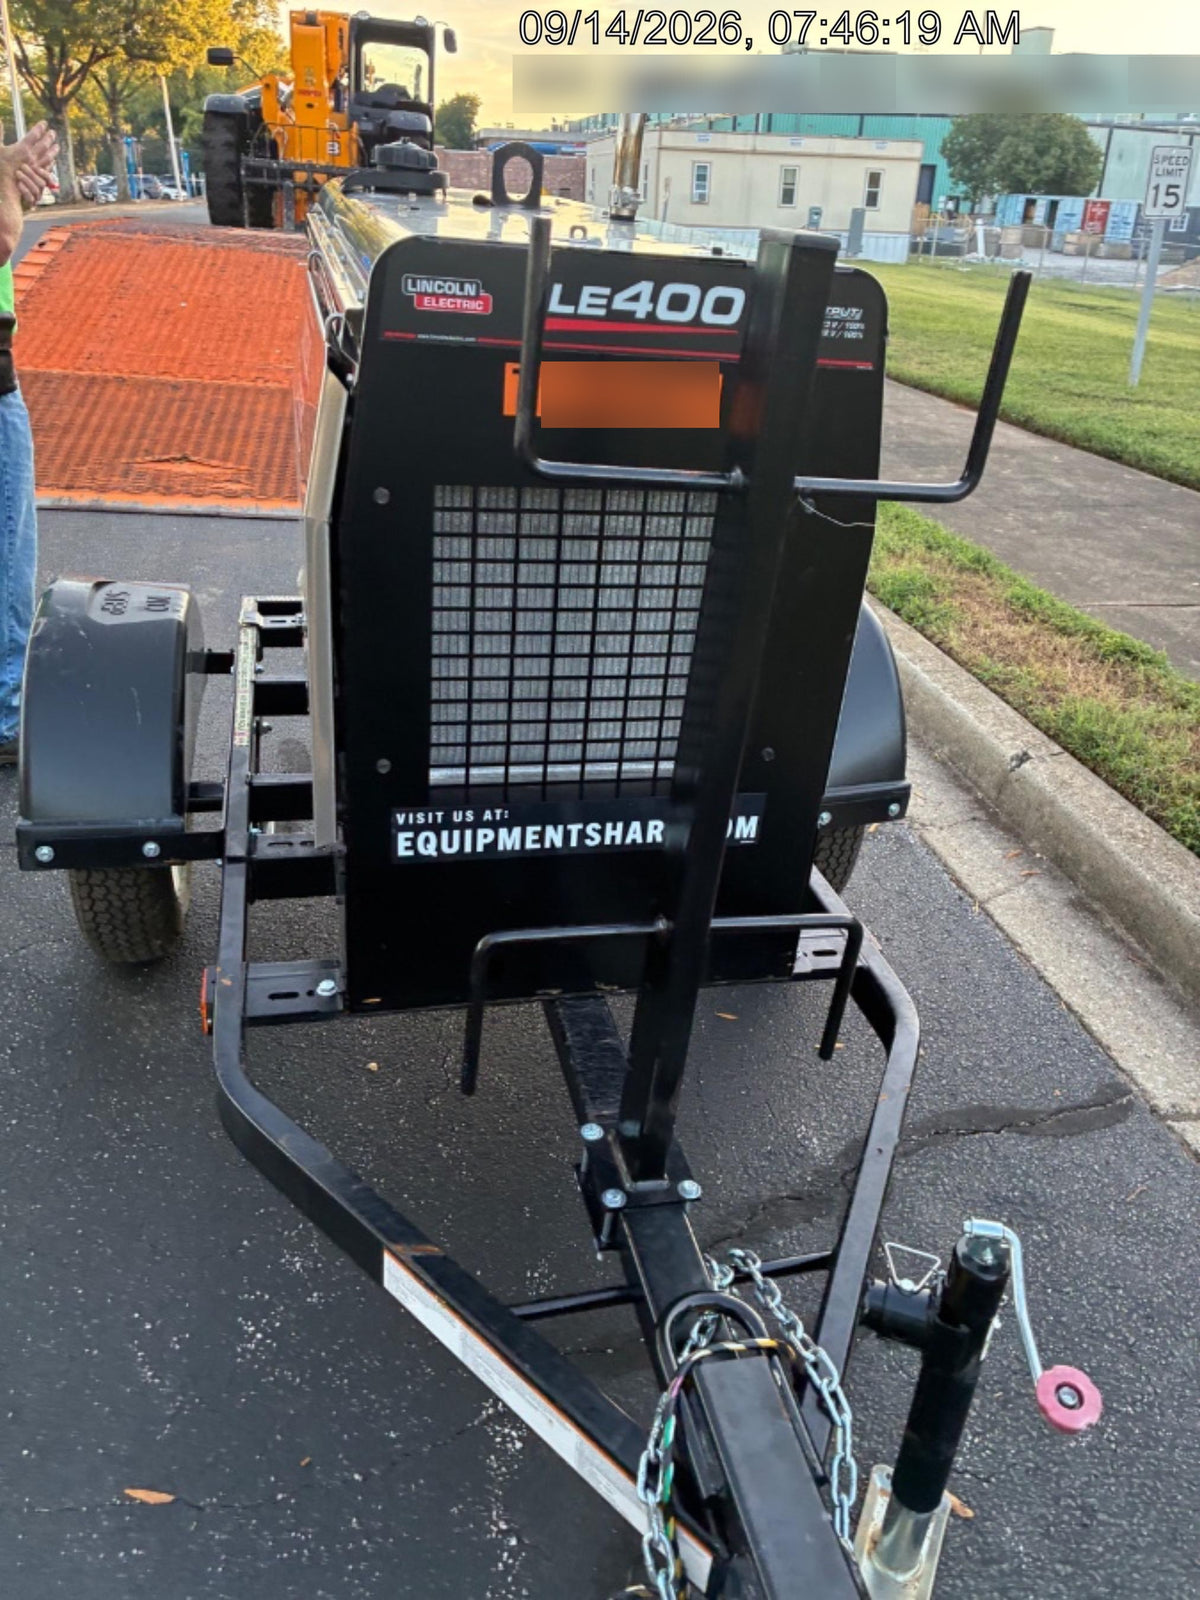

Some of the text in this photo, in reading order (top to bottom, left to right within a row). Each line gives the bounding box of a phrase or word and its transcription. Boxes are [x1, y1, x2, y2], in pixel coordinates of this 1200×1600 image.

[1153, 155, 1189, 166] SPEED
[1155, 168, 1185, 177] LIMIT
[1152, 183, 1181, 209] 15
[407, 278, 477, 296] LINCOLN
[423, 296, 485, 310] ELECTRIC
[547, 280, 746, 325] LE400
[396, 809, 509, 825] VISIT US AT:
